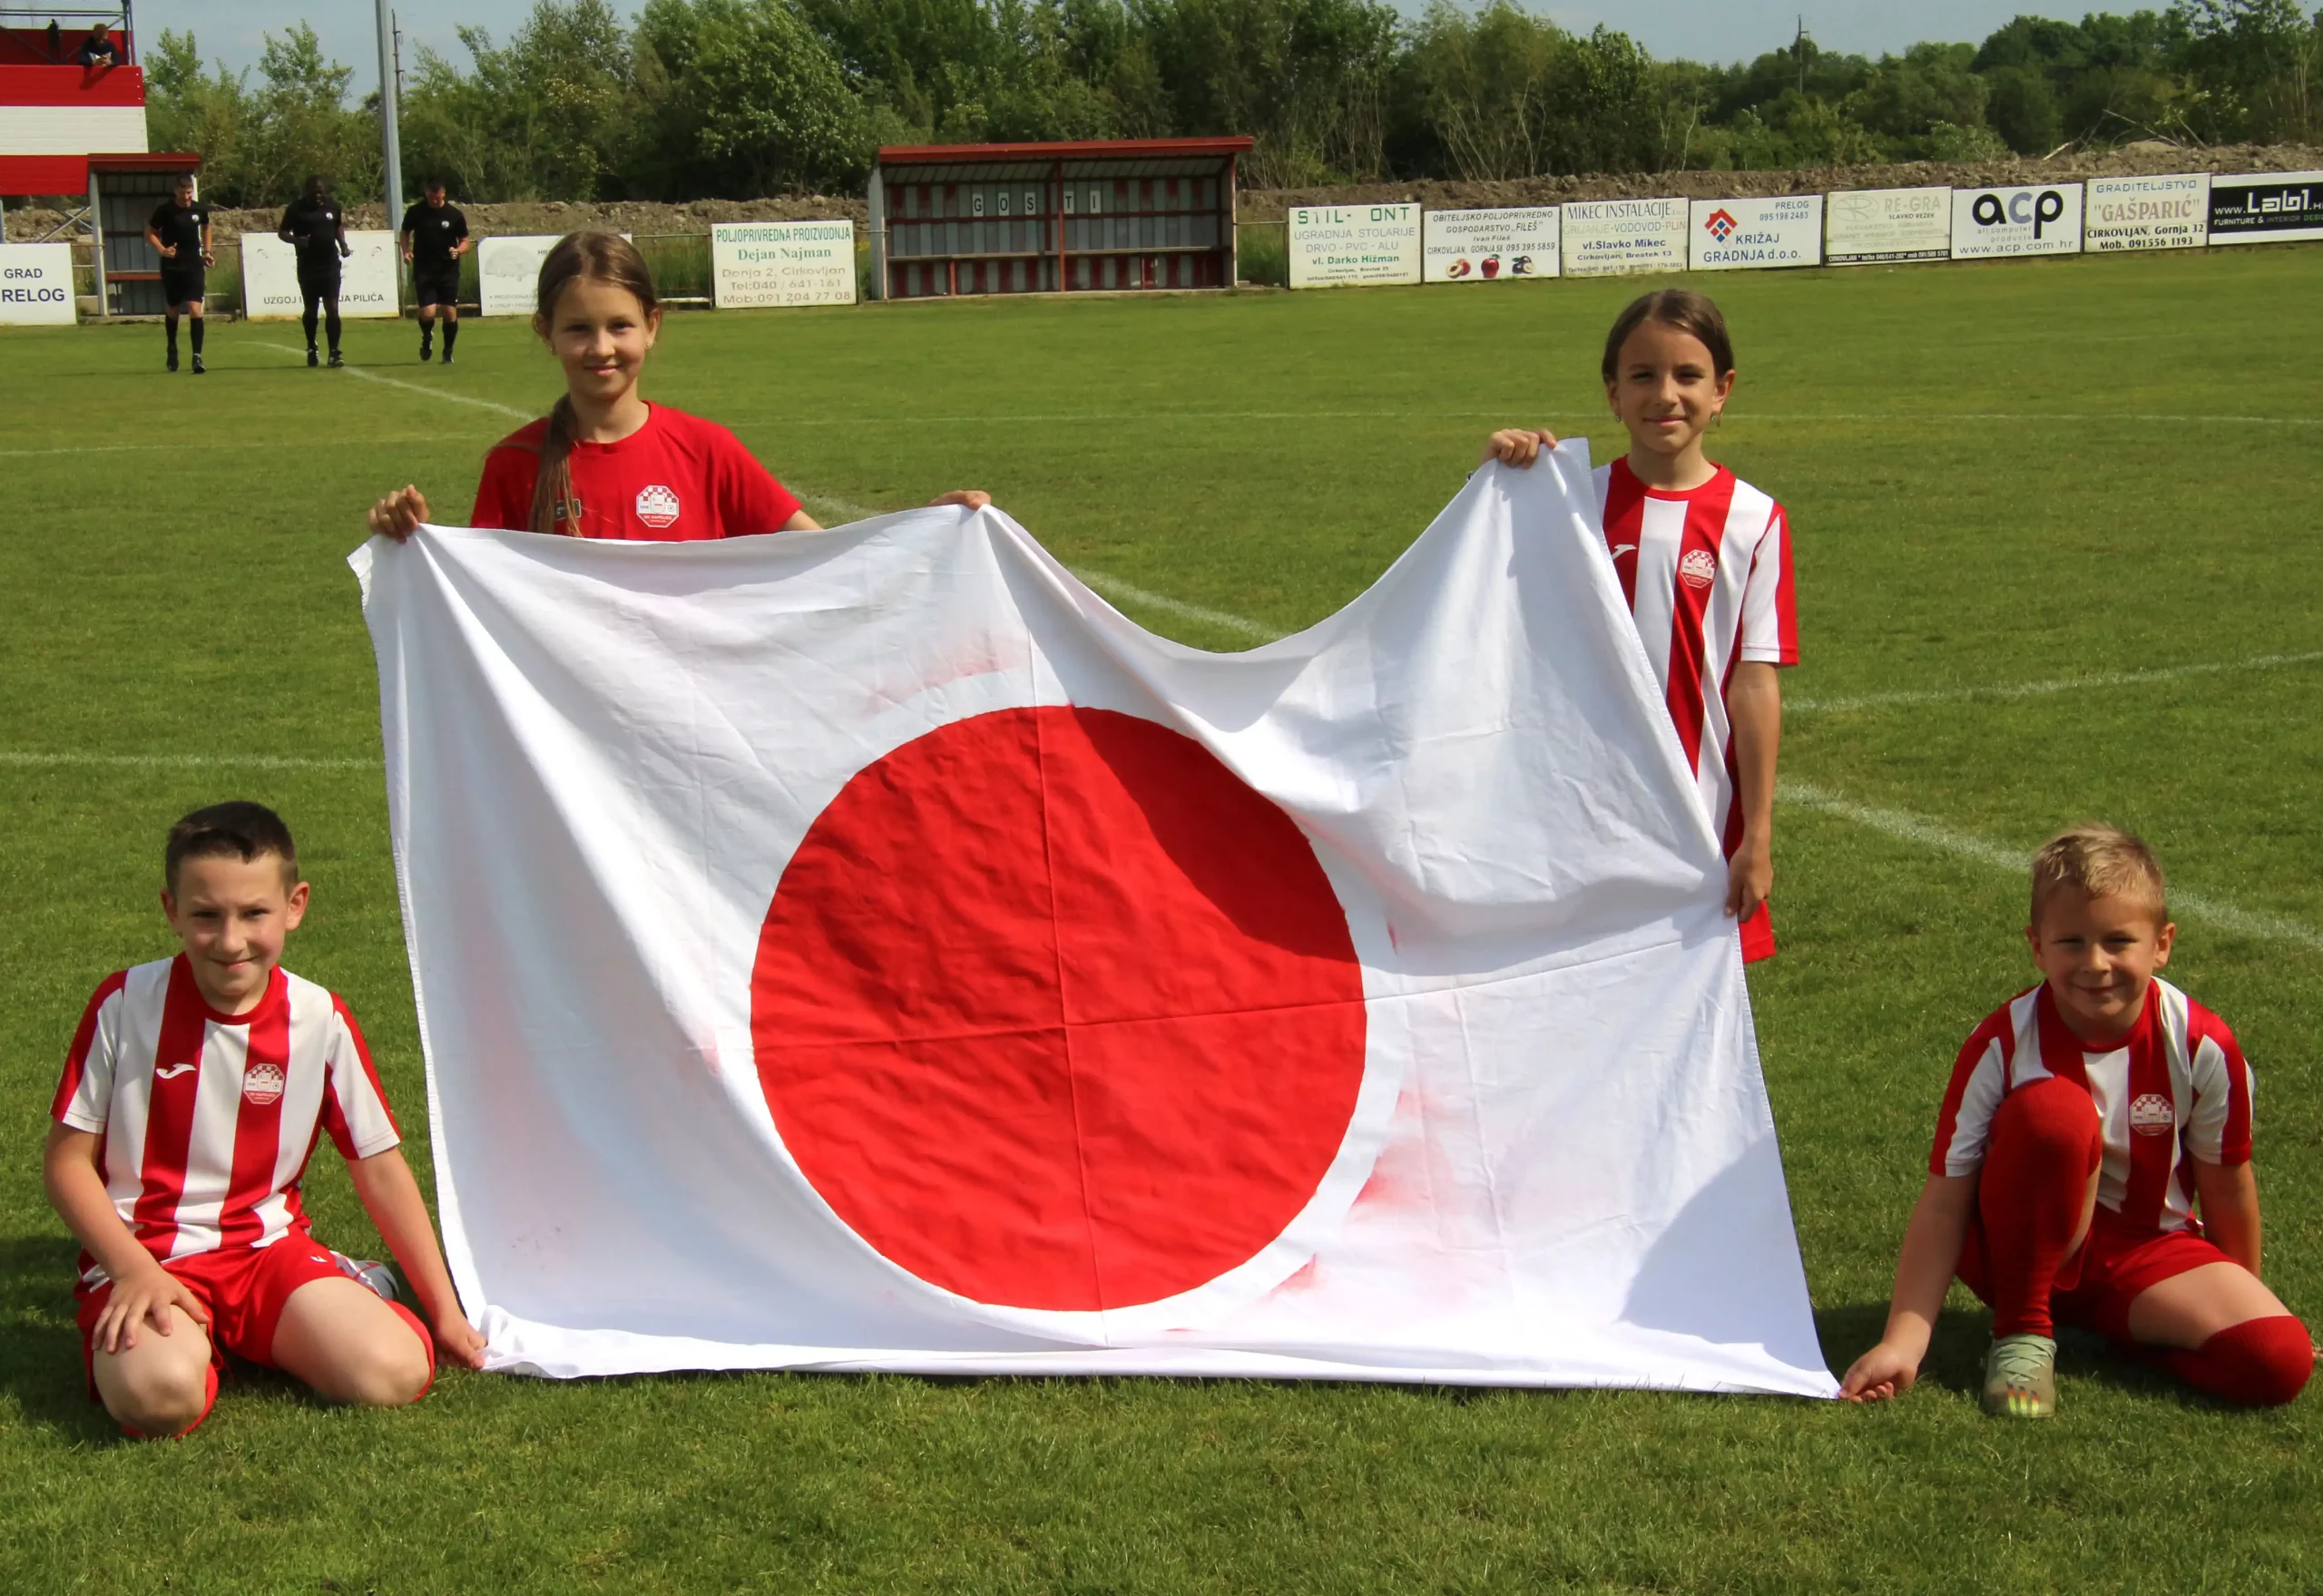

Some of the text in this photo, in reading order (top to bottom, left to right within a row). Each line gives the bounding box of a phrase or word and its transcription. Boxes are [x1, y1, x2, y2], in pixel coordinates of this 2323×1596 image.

[2096, 180, 2197, 193] GRADITELJSTVO
[1567, 204, 1603, 220] MIKEC
[1605, 201, 1671, 219] INSTALACIJE
[1775, 201, 1809, 210] PRELOG
[1884, 196, 1942, 213] RE-GRA
[1433, 211, 1554, 222] OBITELJSKO POLJOPRIVREDNO
[1759, 213, 1774, 221] 095
[1790, 211, 1809, 220] 2483
[1972, 190, 2063, 240] acp
[2214, 217, 2255, 226] FURNITURE
[2258, 216, 2264, 224] &
[716, 227, 851, 242] POLJOPRIVREDNA PROIZVODNJA
[1294, 227, 1416, 240] UGRADNJA STOLARIJE
[1446, 224, 1511, 233] GOSPODARSTVO
[2087, 224, 2204, 239] CIRKOVLJAN, Gornja 32
[1634, 239, 1666, 248] Mikec
[1735, 231, 1780, 245] KRIŽAJ
[1990, 235, 2033, 243] products
[2099, 240, 2124, 250] Mob.
[2171, 236, 2193, 246] 1193
[1306, 243, 1337, 253] DRVO
[1345, 242, 1368, 251] PVC
[1377, 241, 1399, 250] ALU
[1470, 245, 1495, 253] GORNJA
[1536, 242, 1555, 250] 5859
[738, 247, 832, 262] Dejan Najman
[1312, 255, 1400, 265] vl. Darko Hižman
[1703, 249, 1801, 262] GRADNJA d.o.o.
[4, 268, 43, 279] GRAD
[722, 269, 761, 279] Donja
[781, 266, 846, 277] Cirkovljan
[264, 296, 297, 305] UZGOJ
[786, 293, 810, 303] 204
[816, 292, 830, 300] 77
[835, 291, 851, 300] 08
